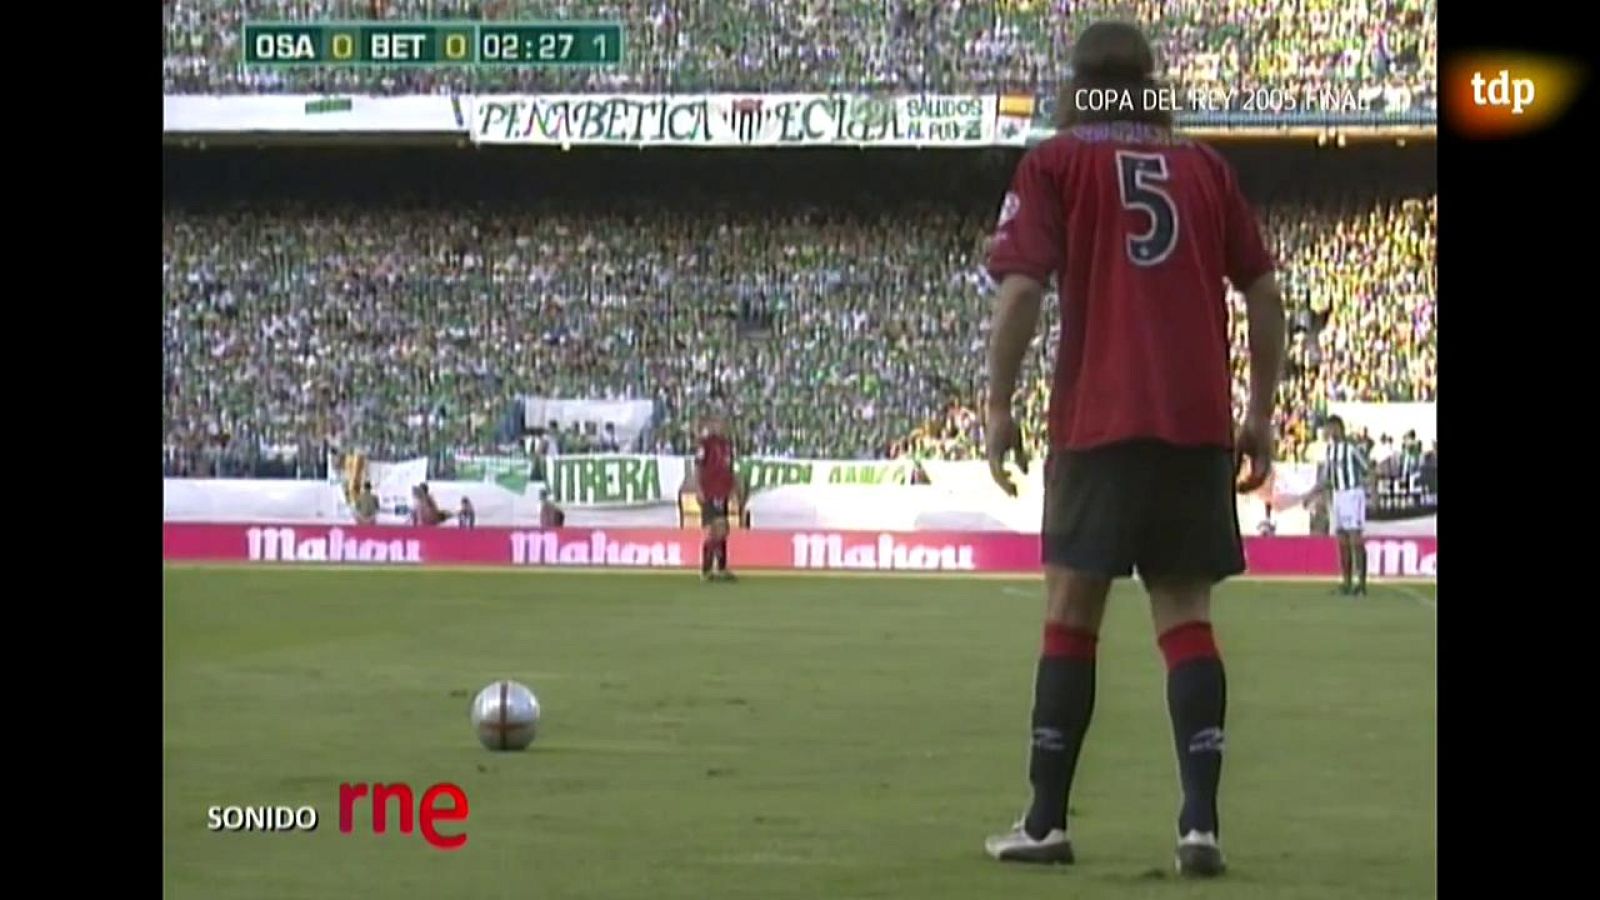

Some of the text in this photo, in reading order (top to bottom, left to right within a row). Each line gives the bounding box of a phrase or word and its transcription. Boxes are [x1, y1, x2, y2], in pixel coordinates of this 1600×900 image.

[1115, 150, 1179, 266] 5
[247, 528, 422, 564] Mahou
[510, 531, 683, 567] Mahou
[792, 533, 976, 571] Mahou
